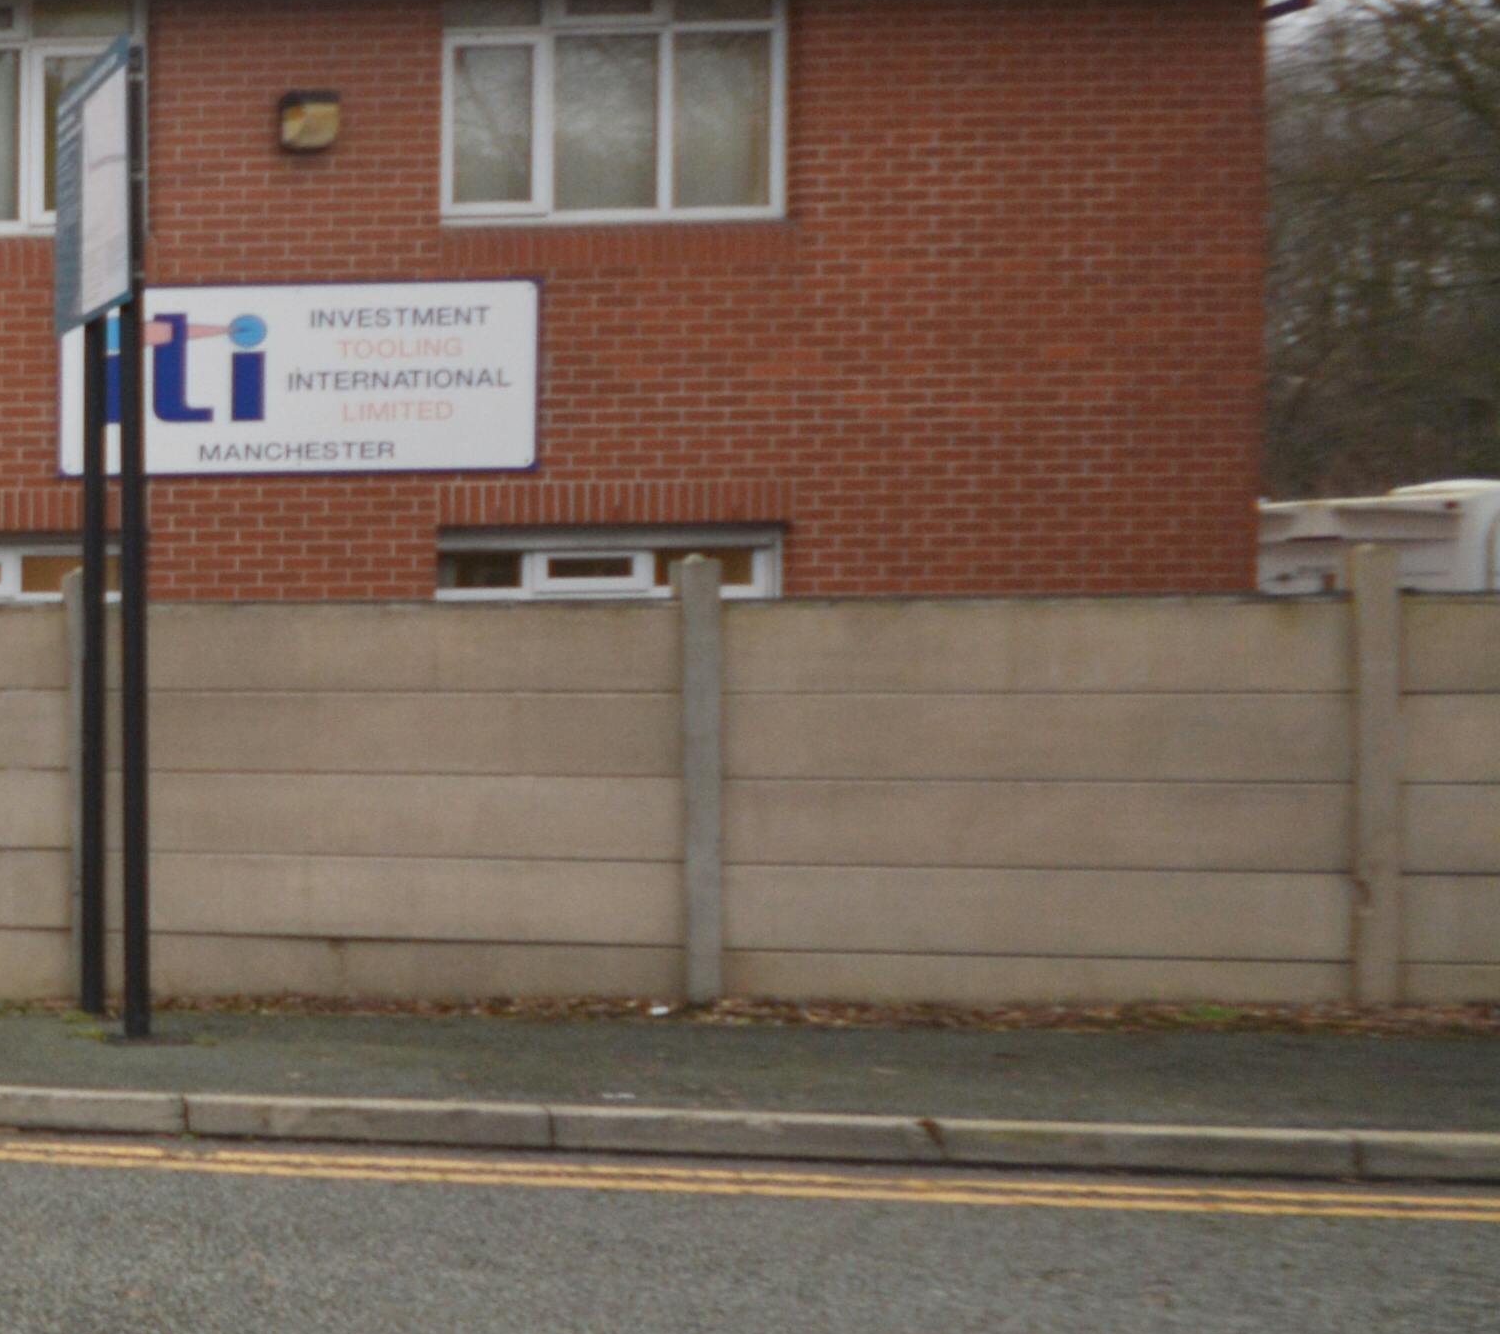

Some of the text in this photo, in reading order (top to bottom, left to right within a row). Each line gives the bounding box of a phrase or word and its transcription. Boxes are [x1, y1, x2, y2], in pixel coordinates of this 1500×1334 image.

[310, 306, 490, 328] INVESTMENT
[337, 337, 463, 360] TOOLING
[287, 368, 512, 392] INTERNATIONAL
[342, 401, 454, 422] LIMITED
[199, 442, 396, 462] MANCHESTER
